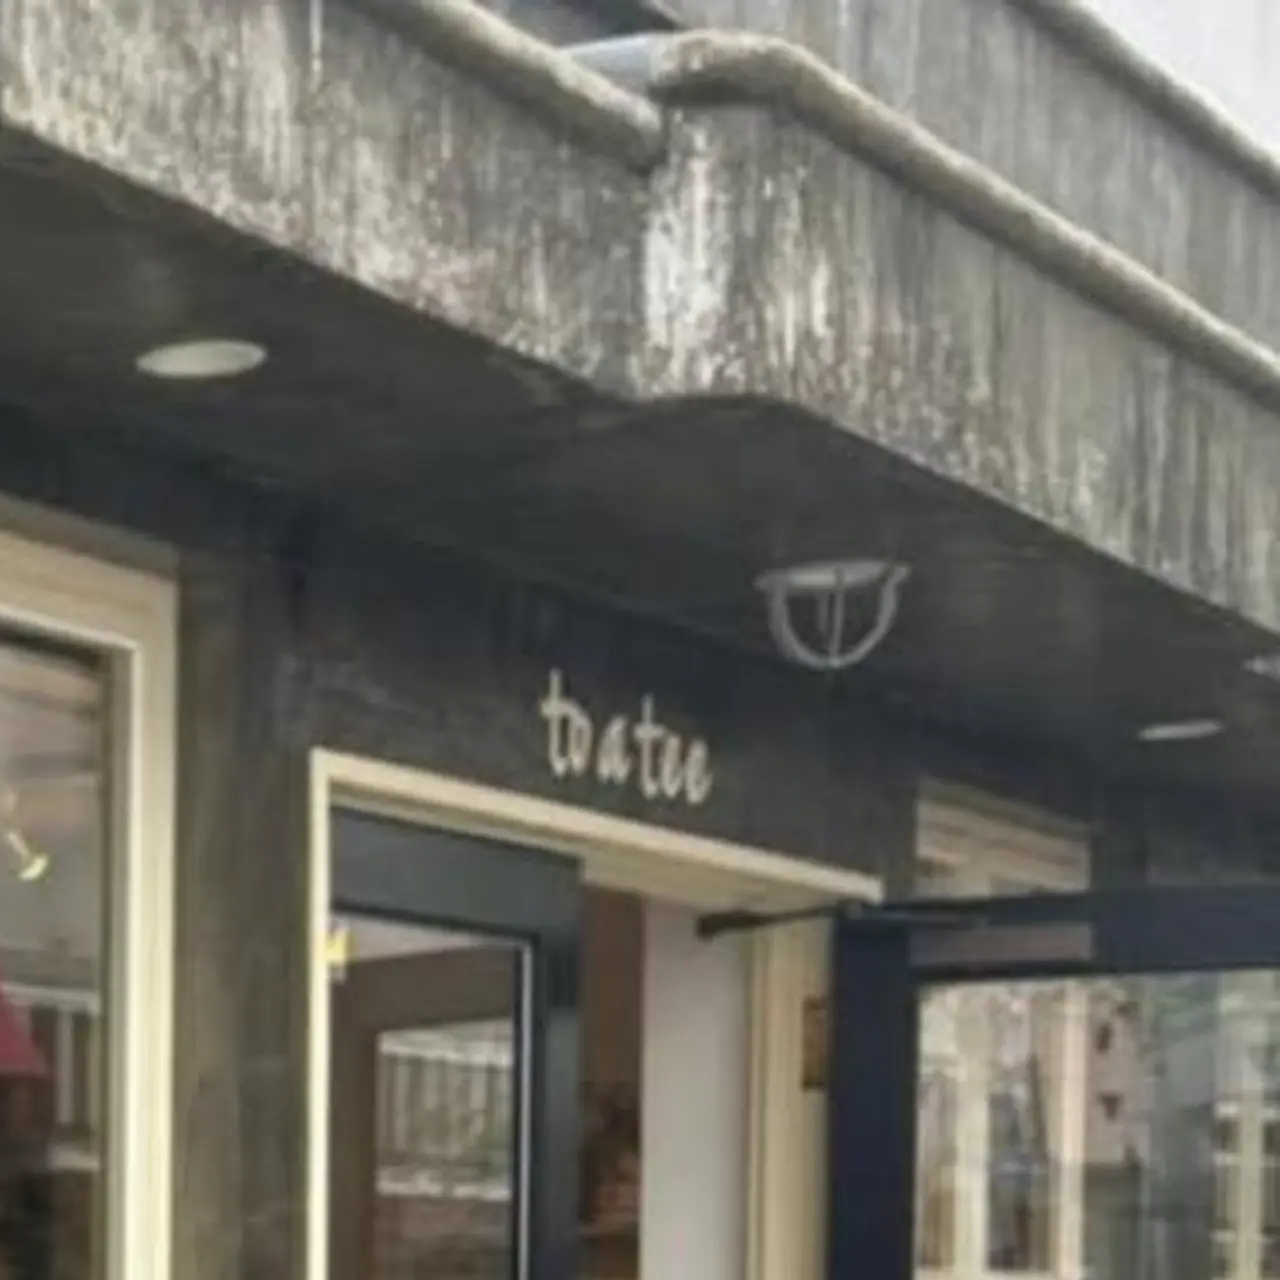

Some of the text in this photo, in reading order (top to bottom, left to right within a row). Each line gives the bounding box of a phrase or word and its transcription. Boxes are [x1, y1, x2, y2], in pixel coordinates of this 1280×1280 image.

[539, 668, 714, 806] to a tee
